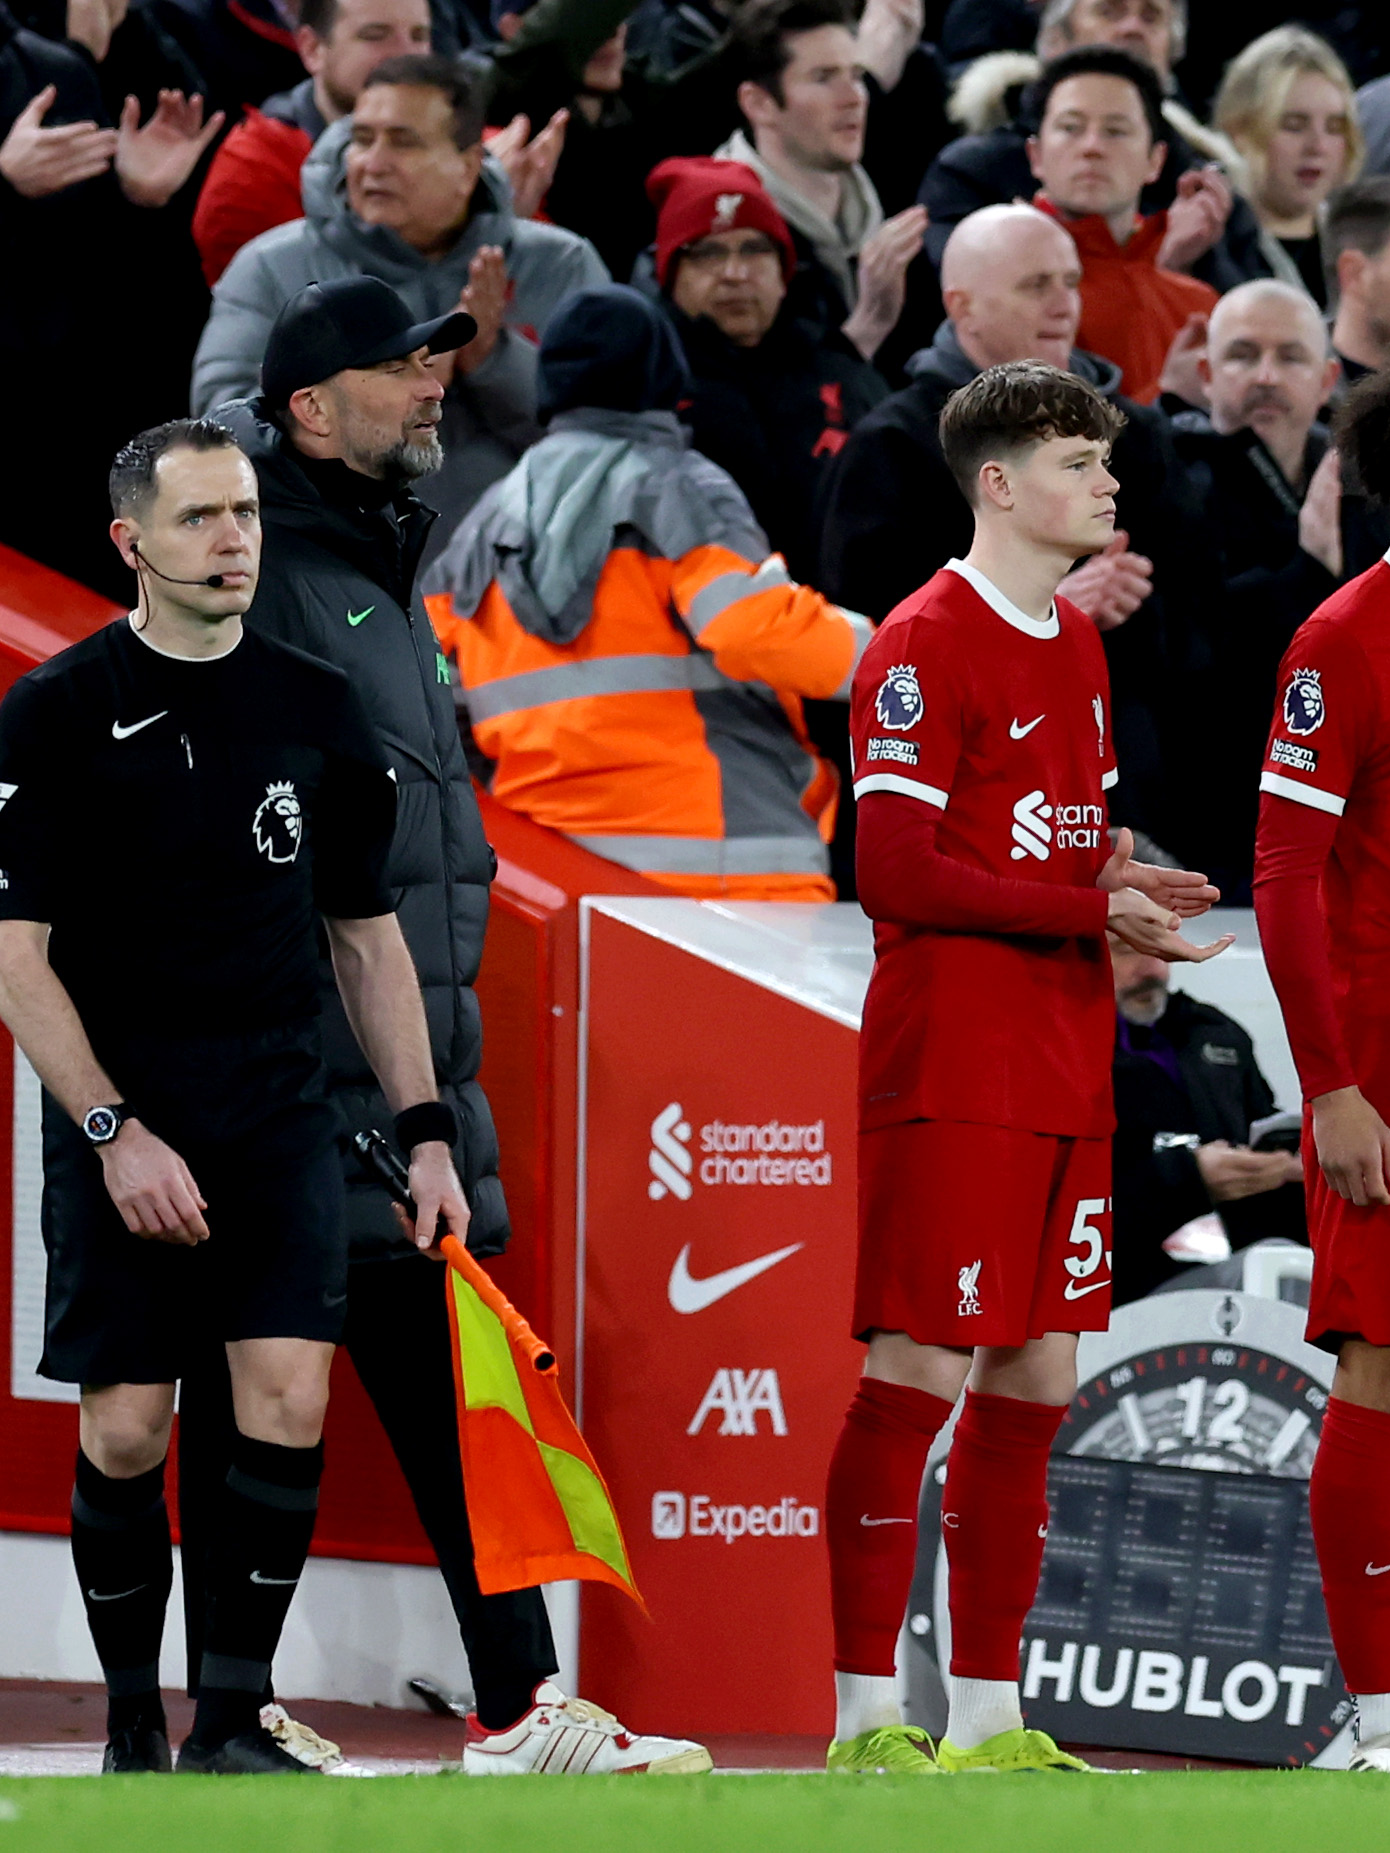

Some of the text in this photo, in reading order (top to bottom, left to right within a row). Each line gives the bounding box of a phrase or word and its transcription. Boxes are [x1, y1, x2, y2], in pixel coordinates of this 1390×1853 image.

[868, 738, 915, 754] No room
[880, 750, 918, 766] racism
[700, 1119, 825, 1152] standard
[700, 1152, 832, 1185] chartered
[686, 1368, 789, 1436] AXA
[1177, 1376, 1250, 1442] 12
[689, 1495, 820, 1545] Expedia
[1022, 1638, 1325, 1726] HUBLOT
